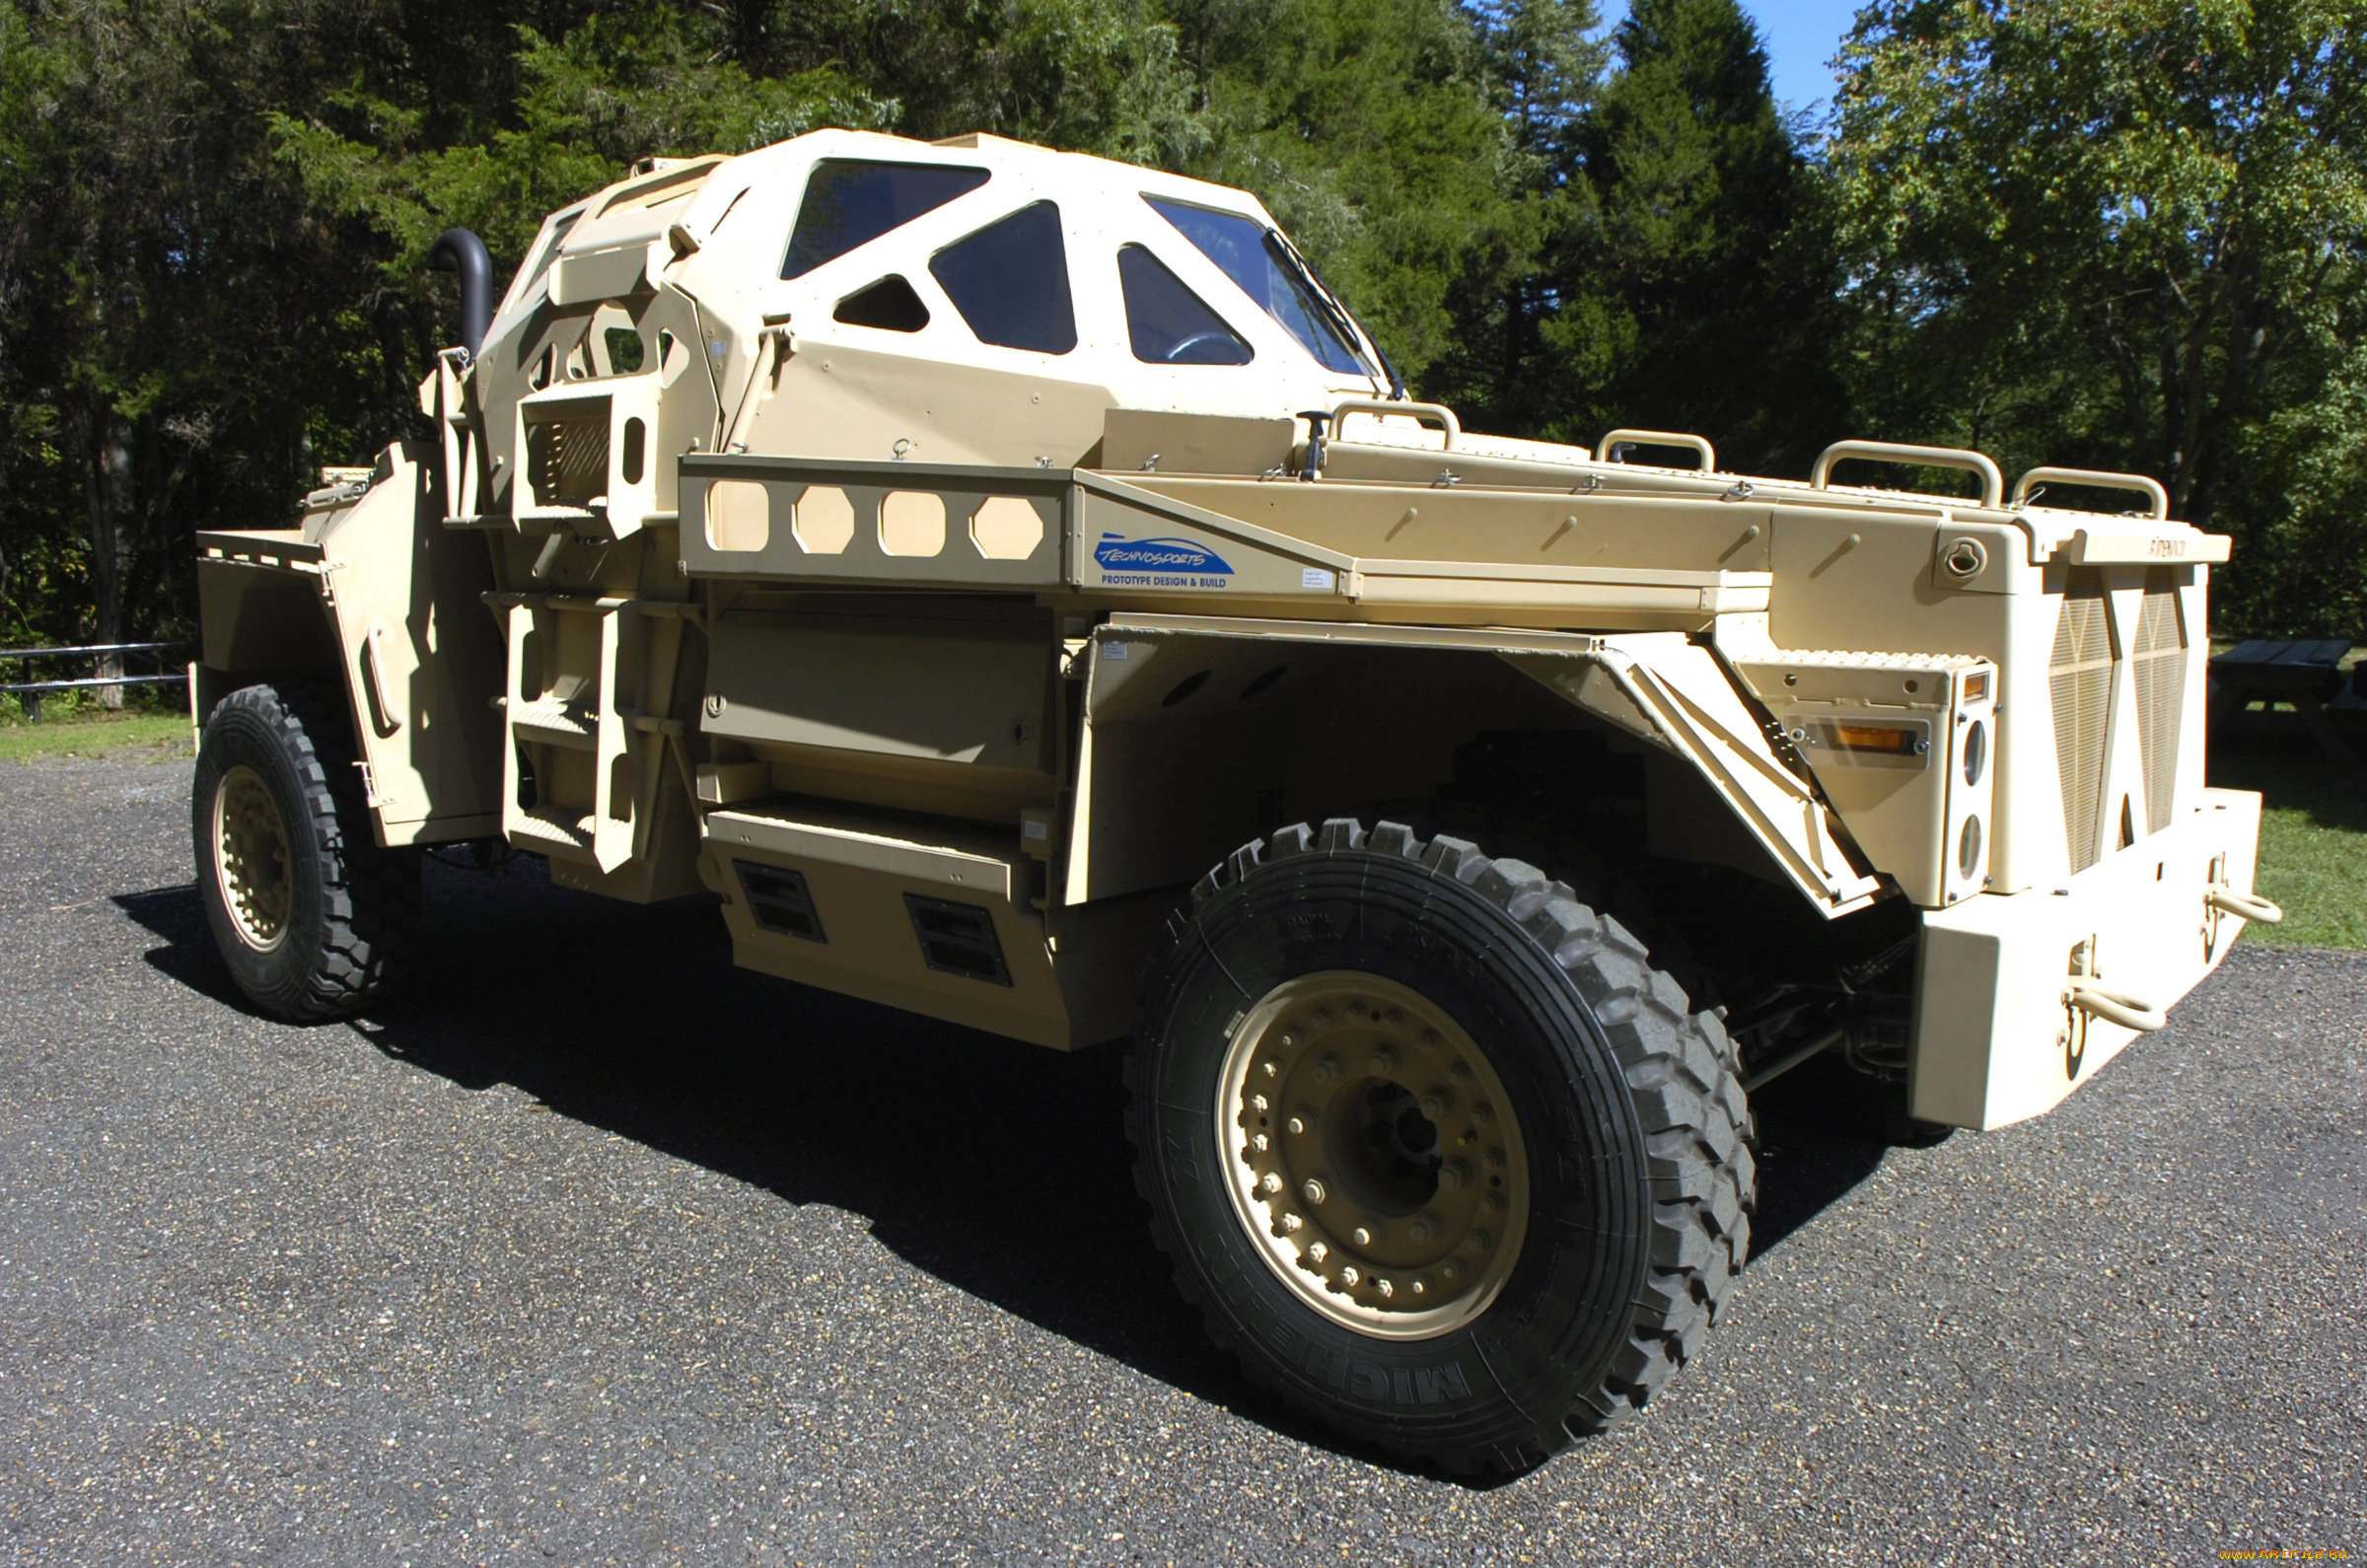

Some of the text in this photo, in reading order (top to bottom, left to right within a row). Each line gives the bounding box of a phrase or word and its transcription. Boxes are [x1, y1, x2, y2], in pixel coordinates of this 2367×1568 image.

[1099, 548, 1206, 565] TECHNOSPORTS
[1102, 574, 1226, 588] PROTOTYPE DESIGN & BUILD
[1197, 1233, 1470, 1406] MICHELIN
